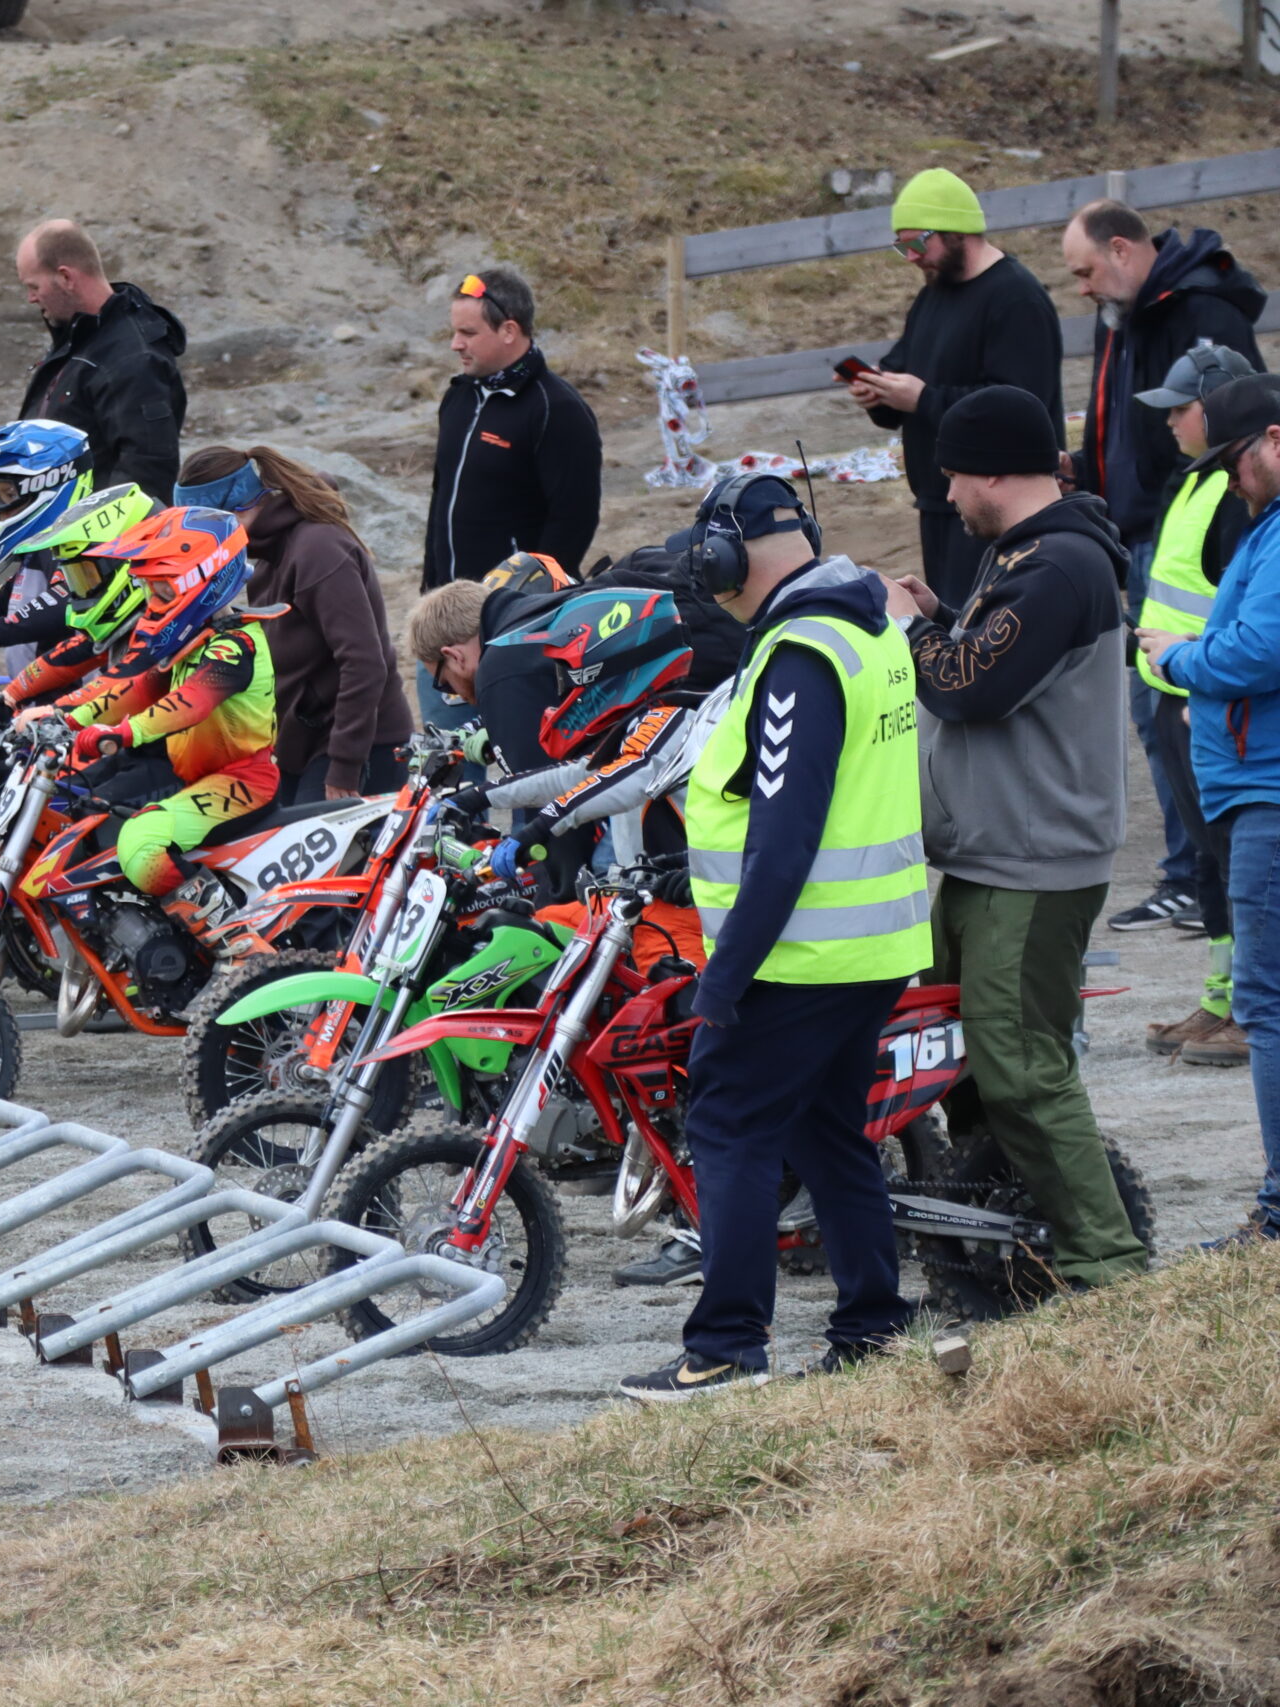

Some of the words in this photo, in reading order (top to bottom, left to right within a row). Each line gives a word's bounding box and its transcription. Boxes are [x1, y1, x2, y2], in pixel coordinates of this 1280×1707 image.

[20, 460, 78, 496] 100%
[82, 501, 127, 539] FOX
[173, 544, 231, 595] 100%
[257, 827, 338, 893] 889
[444, 955, 511, 1011] KX
